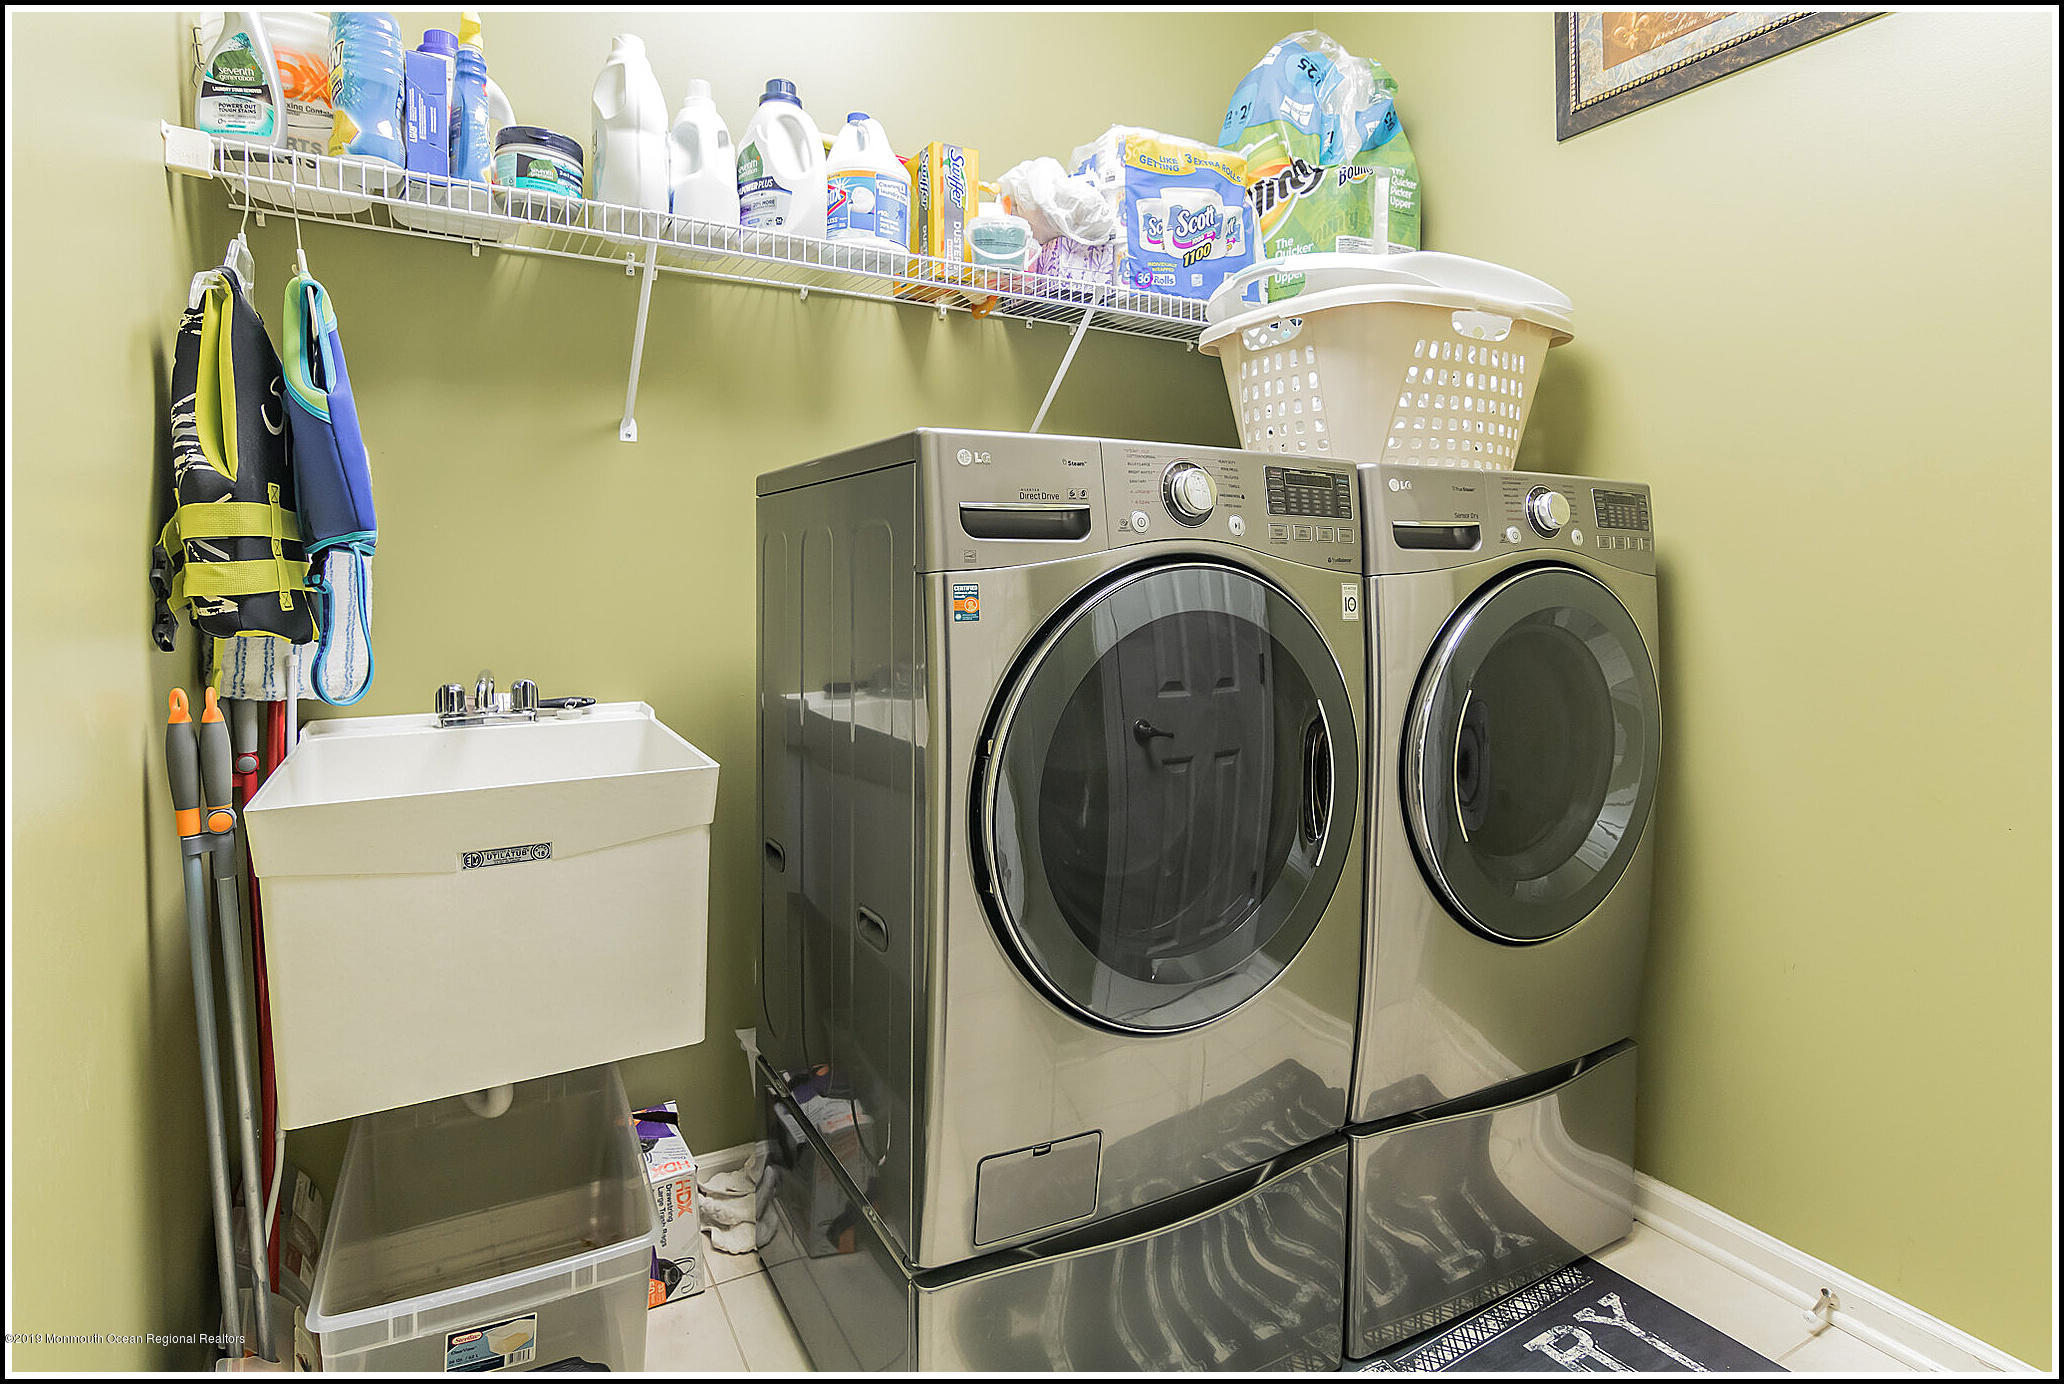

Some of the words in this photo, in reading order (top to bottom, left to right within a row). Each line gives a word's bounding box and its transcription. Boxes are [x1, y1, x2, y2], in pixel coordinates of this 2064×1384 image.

[218, 66, 255, 76] seventh
[1159, 155, 1178, 165] LIKE
[1139, 154, 1180, 172] GETTING
[1185, 153, 1193, 164] 3
[1194, 158, 1220, 169] EXTRA
[1221, 164, 1242, 183] ROLLS
[1390, 167, 1406, 176] The
[919, 153, 930, 211] Swiffer
[948, 147, 968, 208] Swiffer
[1339, 165, 1374, 187] Bounty
[1391, 175, 1417, 189] Quicker
[758, 178, 774, 190] PLUS
[1391, 186, 1413, 199] Picker
[1390, 195, 1412, 209] Upper
[1175, 204, 1217, 238] Scott
[1276, 237, 1294, 247] The
[1183, 242, 1212, 268] 1100
[1275, 242, 1314, 258] Quicker
[1137, 272, 1151, 284] 36
[1154, 274, 1174, 285] Rolls
[1274, 272, 1304, 284] Upper
[974, 451, 992, 464] LG
[1400, 480, 1412, 490] LG
[1019, 491, 1041, 500] Direct
[1041, 492, 1060, 500] Drive
[1471, 512, 1479, 520] Dry
[657, 1185, 665, 1208] Large
[675, 1179, 694, 1218] HDX
[665, 1183, 673, 1224] Drawstring
